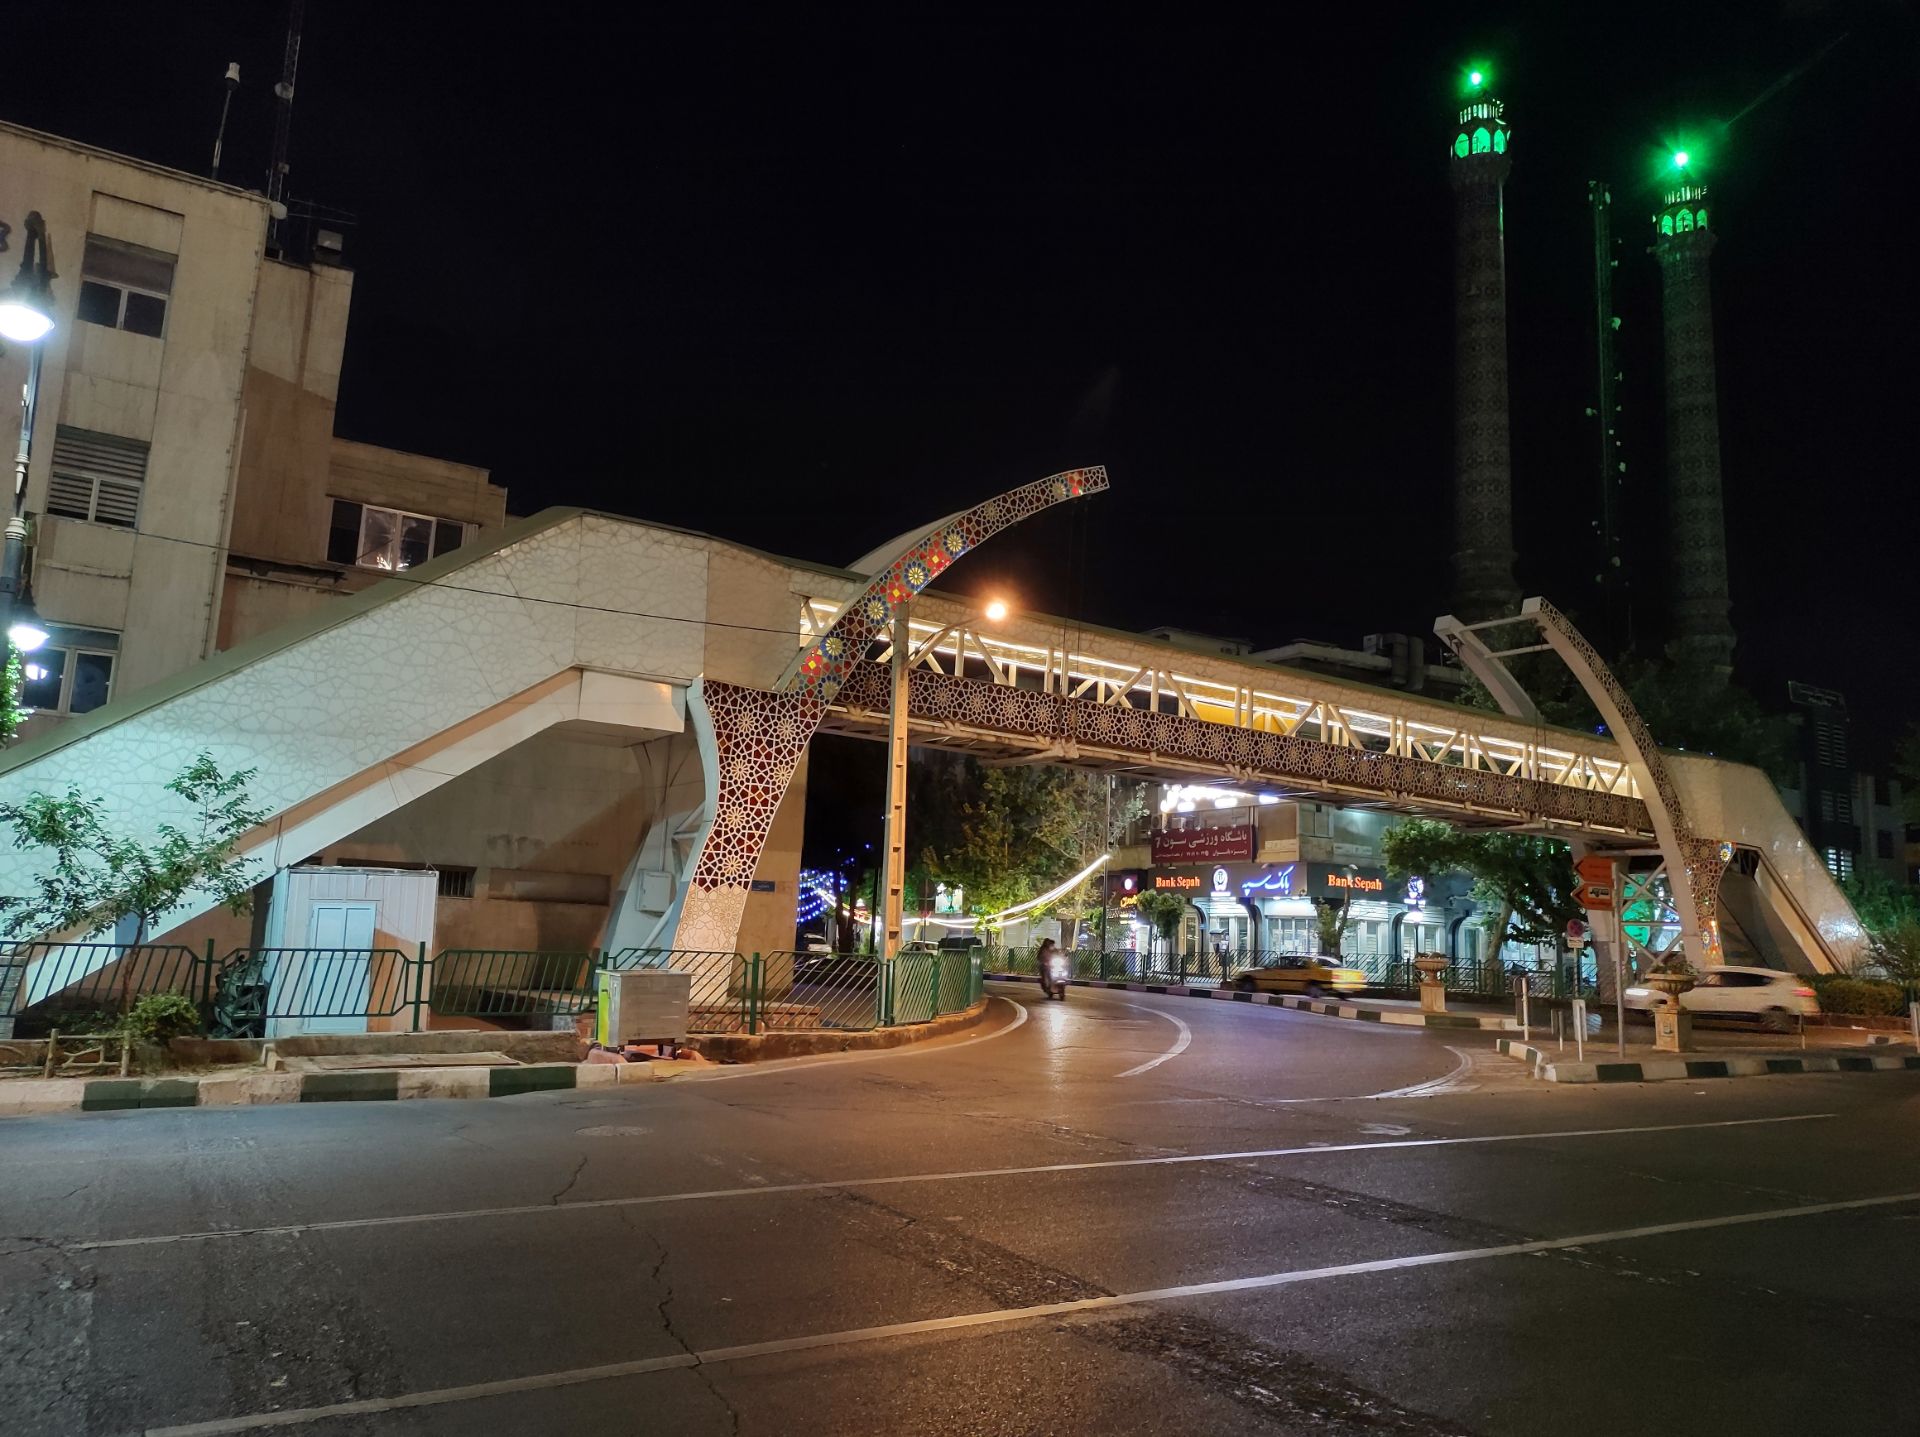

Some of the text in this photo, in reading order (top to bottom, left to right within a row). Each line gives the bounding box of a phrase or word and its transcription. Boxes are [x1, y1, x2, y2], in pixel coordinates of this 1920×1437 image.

[1189, 834, 1218, 848] ورزشی
[1220, 830, 1247, 843] باشگاه
[1155, 876, 1200, 889] Bank Sepah
[1241, 865, 1294, 897] بانک سپه
[1327, 874, 1383, 892] Bank Sepah
